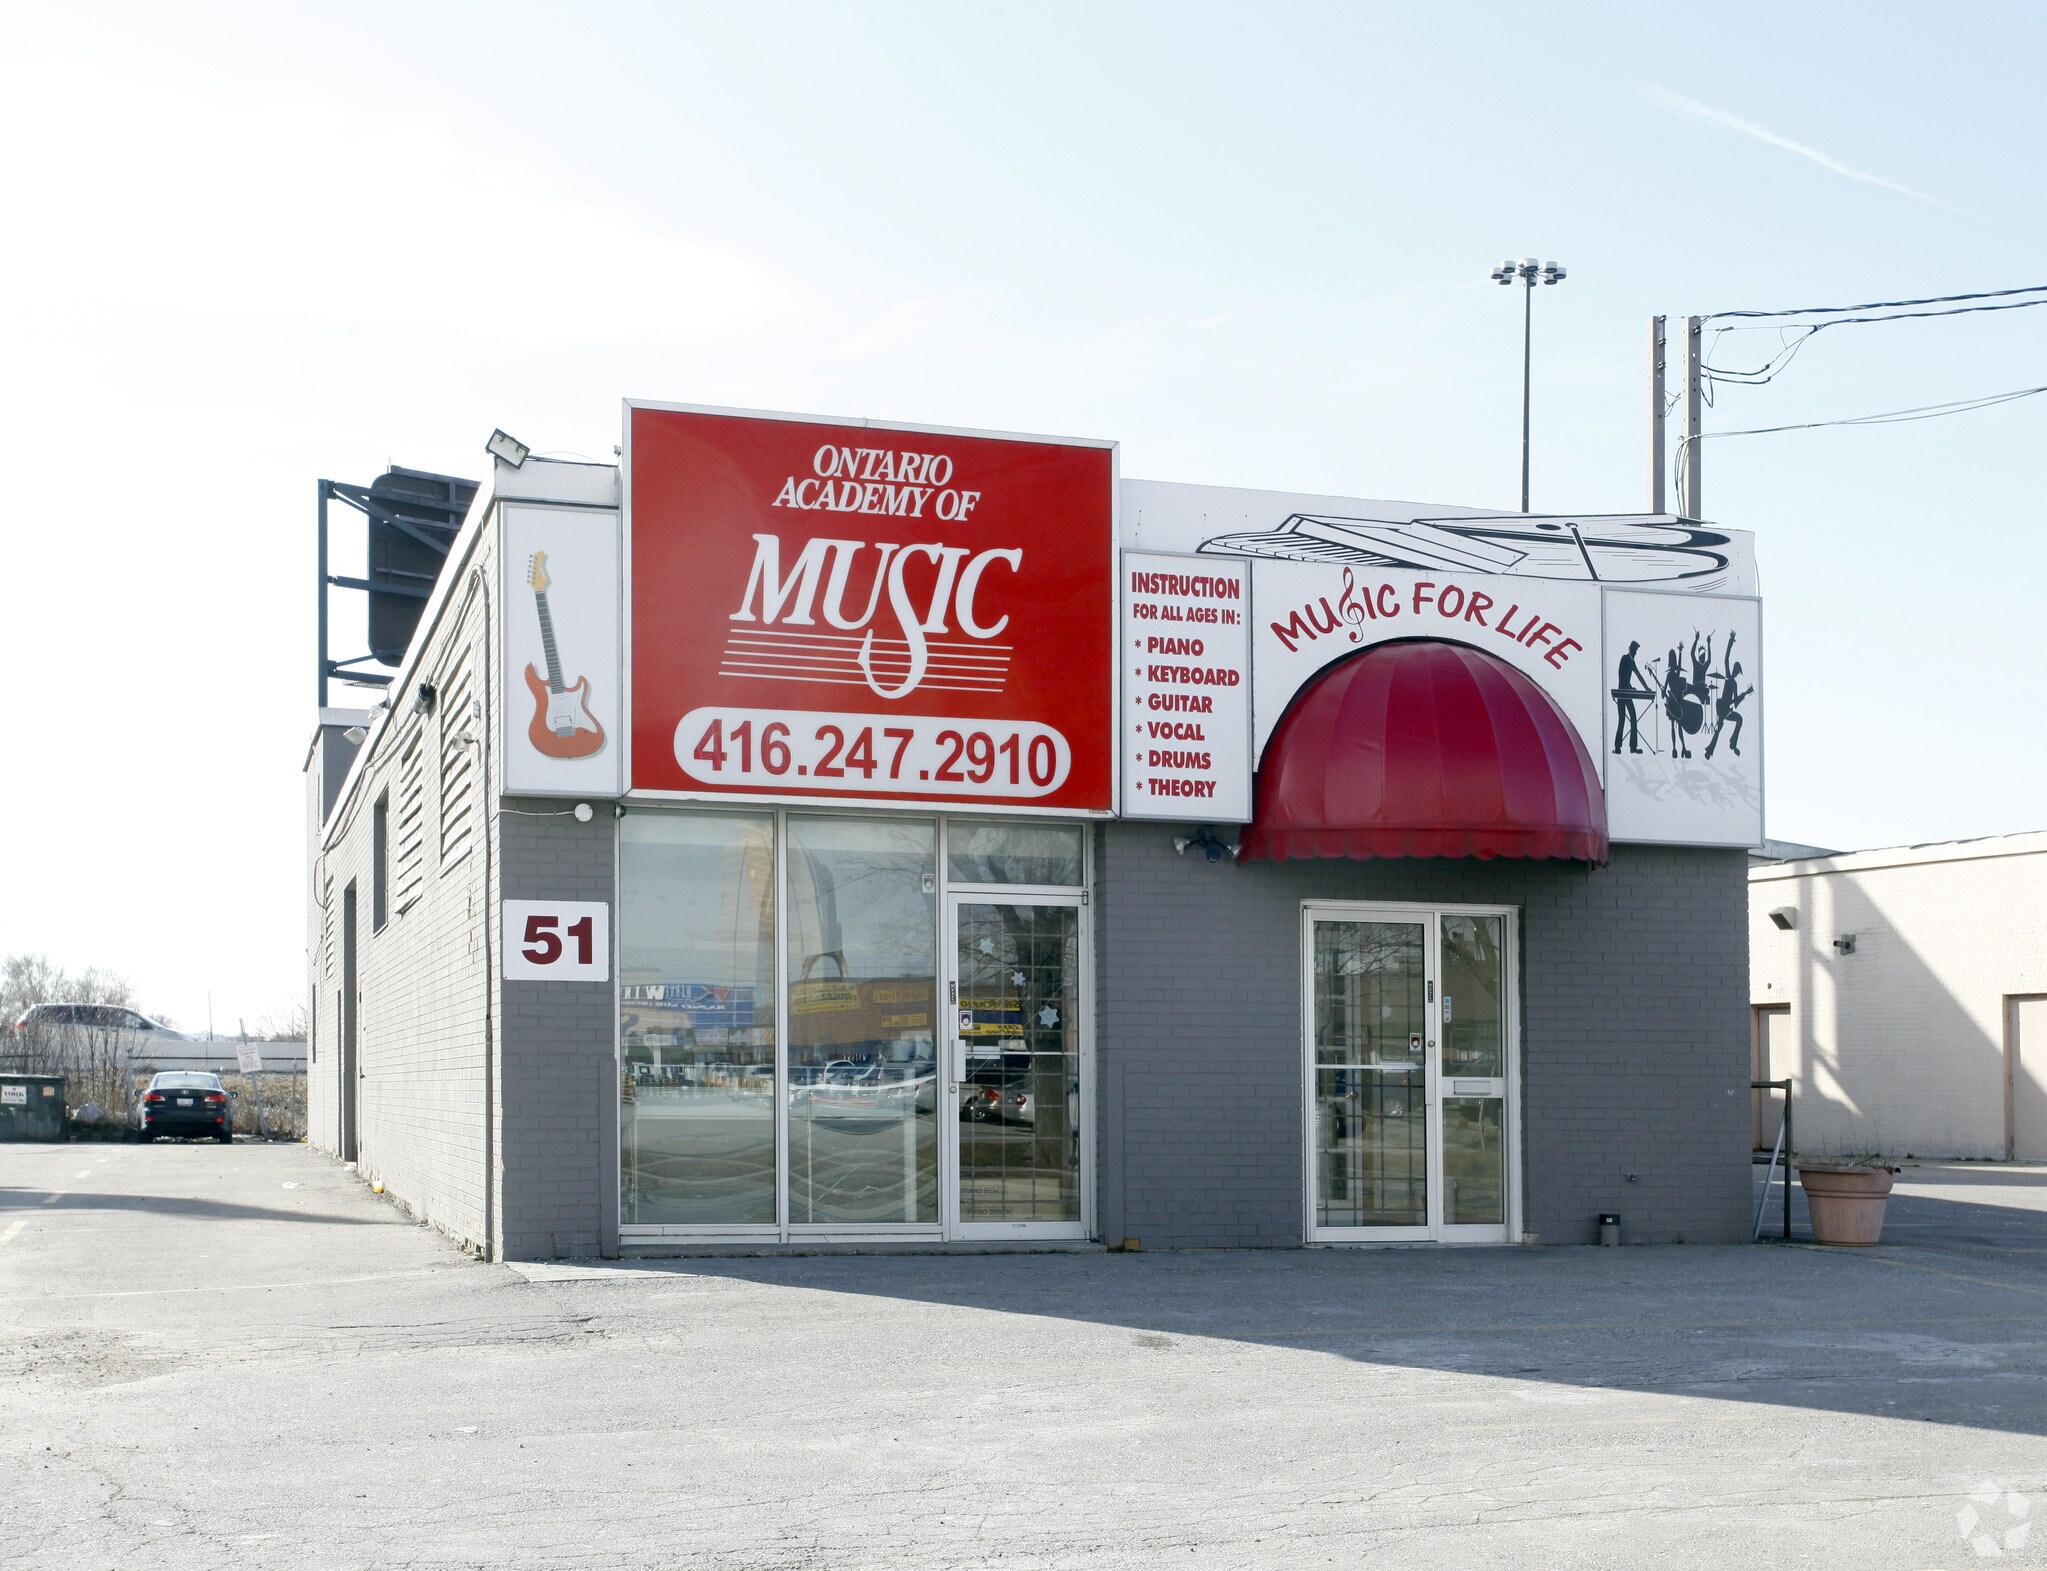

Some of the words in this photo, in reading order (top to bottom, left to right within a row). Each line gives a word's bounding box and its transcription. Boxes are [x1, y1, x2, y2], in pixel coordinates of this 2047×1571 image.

[814, 445, 952, 486] ONTARIO
[772, 476, 934, 518] ACADEMY
[936, 489, 981, 521] OF
[1131, 571, 1240, 600] INSTRUCTION
[729, 533, 1022, 699] MUSIC
[1133, 602, 1158, 619] FOR
[1160, 605, 1183, 622] ALL
[1186, 607, 1219, 624] AGES
[1222, 608, 1240, 625] IN:
[1412, 581, 1494, 627] FOR
[1495, 604, 1583, 670] LIFE
[1147, 636, 1204, 657] PIANO
[1147, 665, 1240, 687] KEYBOARD
[1148, 692, 1213, 713] GUITAR
[1147, 721, 1205, 742] VOCAL
[693, 719, 1057, 787] 416.247.2910
[1148, 749, 1212, 771] DRUMS
[1148, 778, 1217, 799] THEORY
[522, 915, 592, 965] 51
